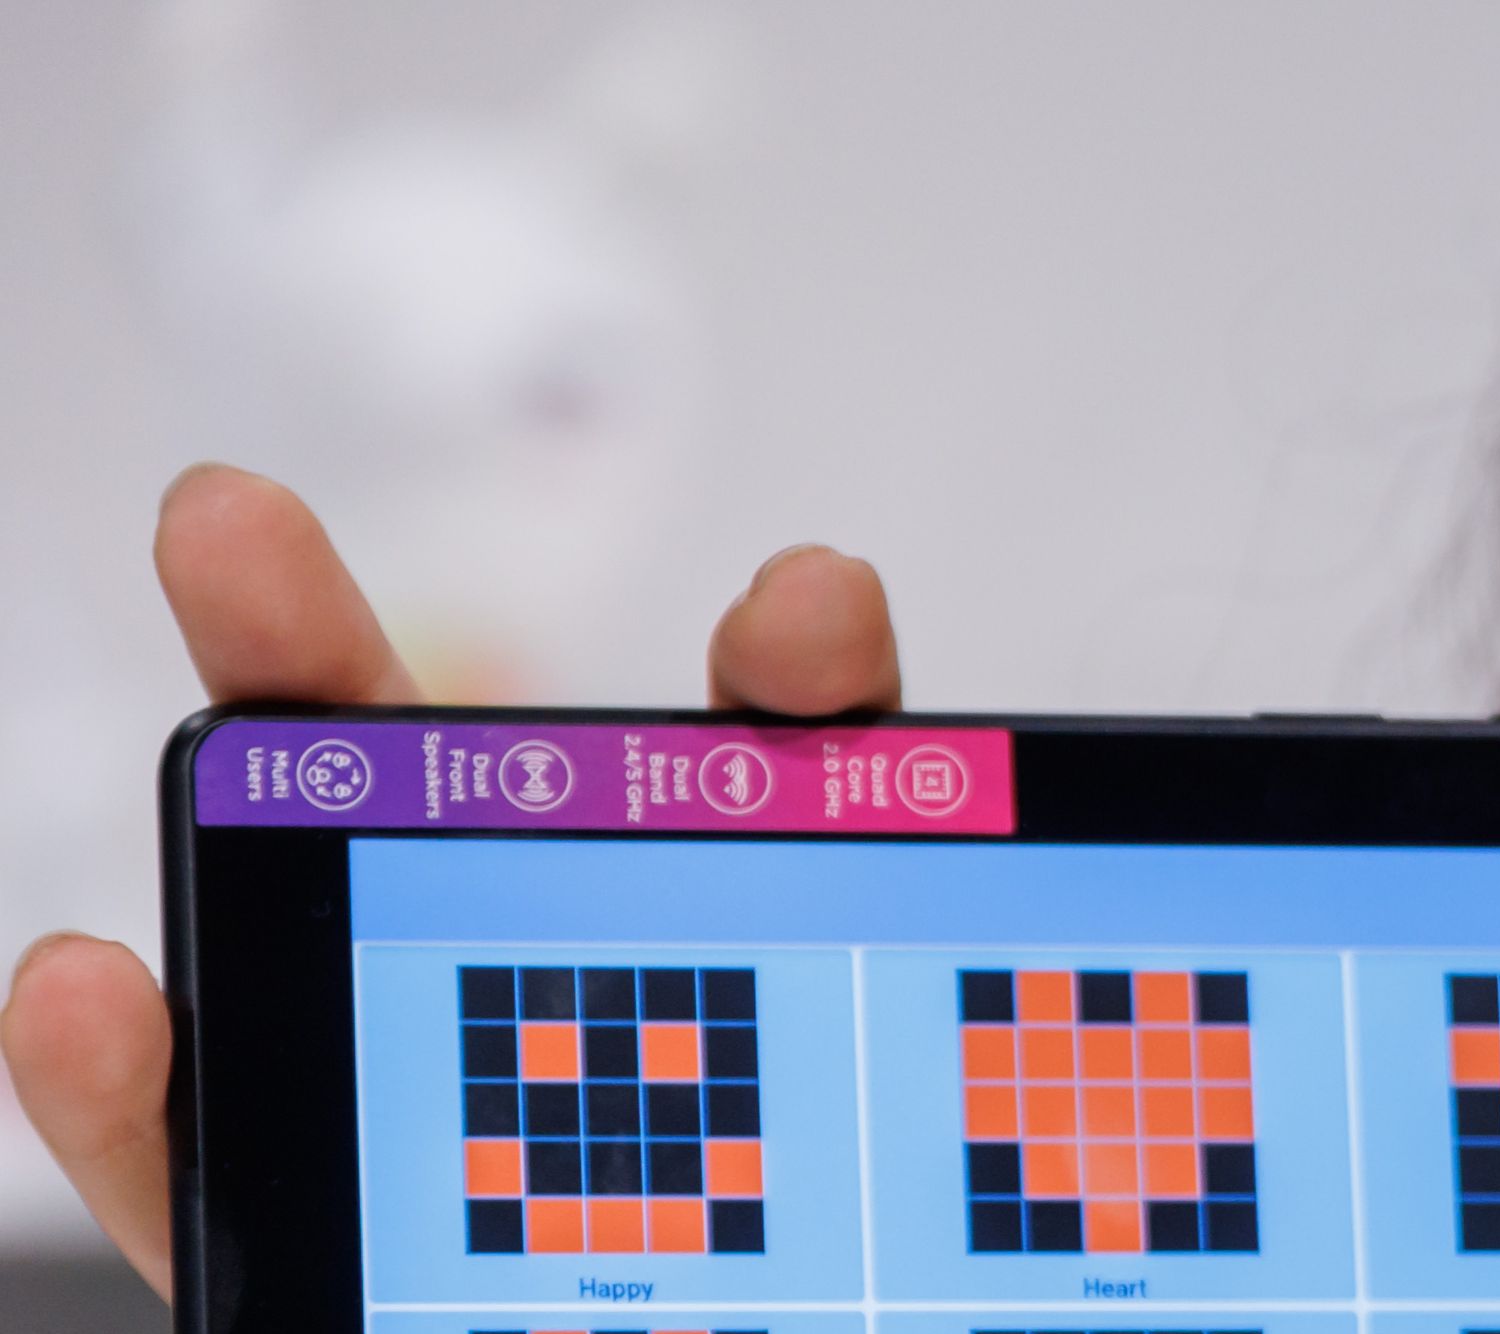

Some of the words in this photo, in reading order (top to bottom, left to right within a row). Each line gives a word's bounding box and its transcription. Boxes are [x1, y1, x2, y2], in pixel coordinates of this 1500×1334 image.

[247, 746, 263, 801] Users
[272, 750, 289, 799] Multi
[424, 731, 440, 820] Speakers
[449, 748, 466, 802] Front
[472, 753, 490, 799] Dual
[648, 752, 667, 804] Band
[672, 756, 689, 801] Dual
[823, 742, 840, 773] 2.0
[847, 756, 864, 803] Core
[871, 753, 888, 808] Quad
[626, 785, 643, 823] GHz
[824, 778, 840, 819] GHz
[579, 1276, 655, 1302] Happy
[1083, 1278, 1147, 1298] Heart
